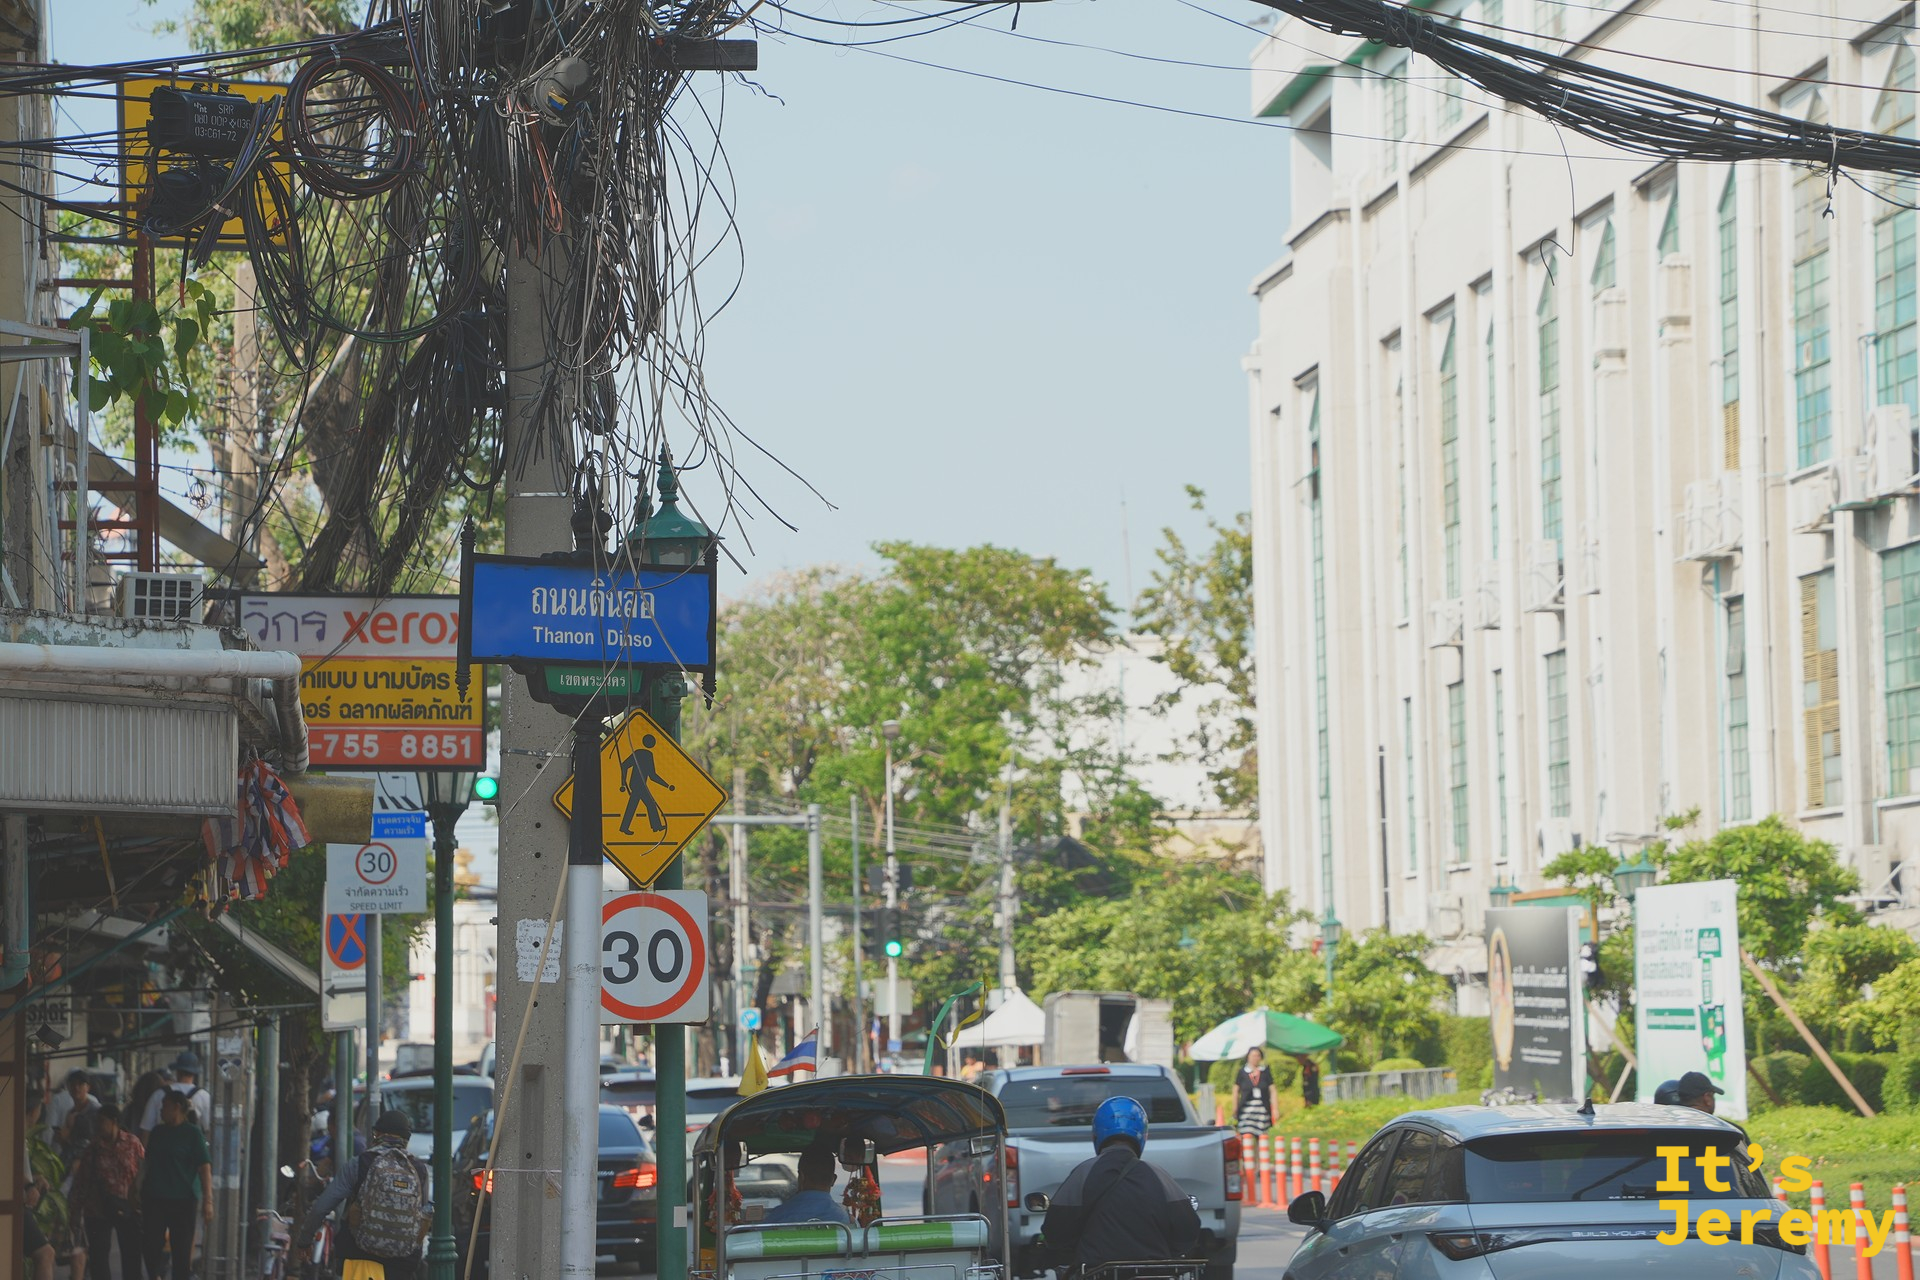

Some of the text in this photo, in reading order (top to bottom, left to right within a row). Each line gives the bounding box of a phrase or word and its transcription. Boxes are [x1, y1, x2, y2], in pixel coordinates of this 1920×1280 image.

[531, 578, 656, 620] ถนนดินสอ
[533, 626, 653, 649] Thanon Dinso
[364, 665, 450, 690] นามบัตร
[339, 697, 473, 720] ฉลากผลิตภัณฑ์
[401, 733, 472, 759] 8851
[363, 852, 391, 873] 30
[345, 884, 409, 897] จำกัดความเร็ว
[350, 901, 403, 911] SPEED LIMIT
[602, 928, 684, 985] 30
[1611, 1229, 1647, 1237] YOUR
